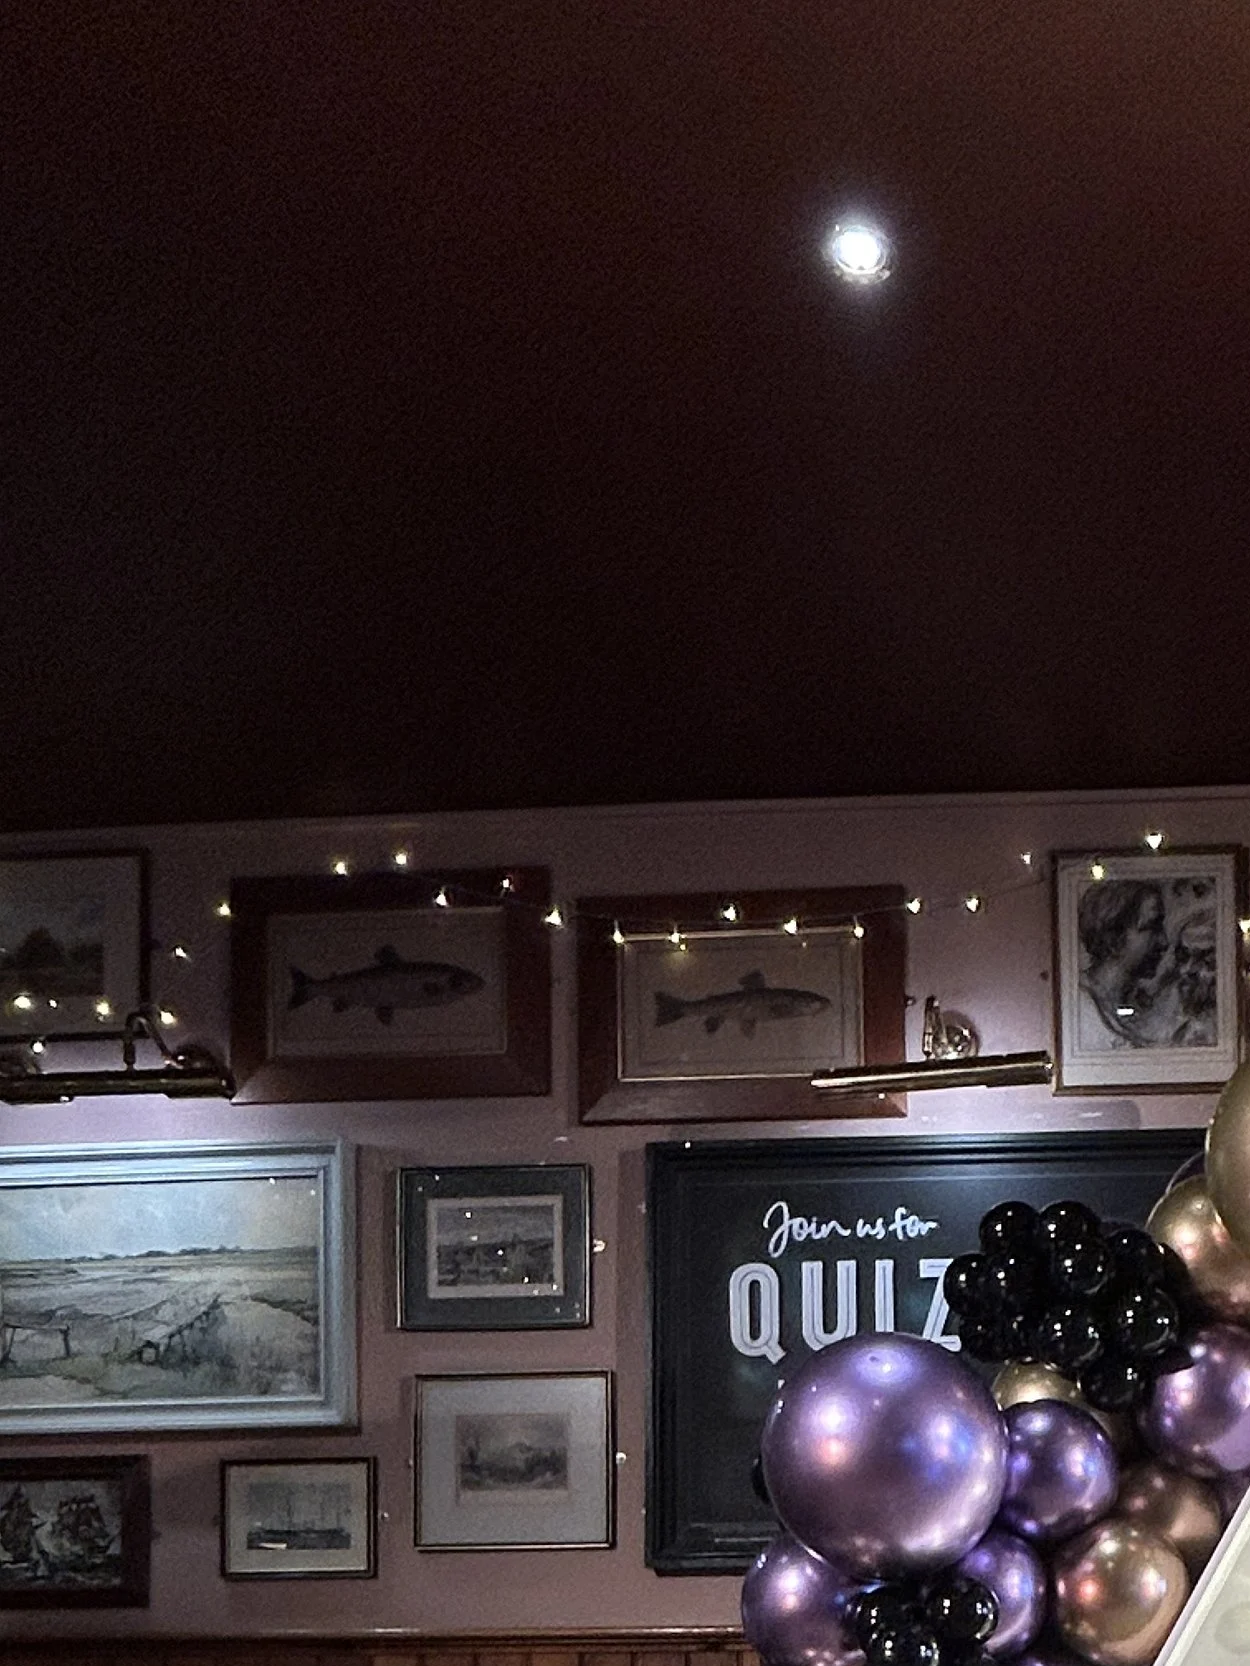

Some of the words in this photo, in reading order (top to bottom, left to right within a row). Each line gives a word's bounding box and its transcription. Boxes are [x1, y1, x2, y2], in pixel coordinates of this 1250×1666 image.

[762, 1200, 851, 1258] Join
[856, 1216, 886, 1240] us
[888, 1206, 939, 1241] for
[728, 1257, 962, 1365] QUIZ
